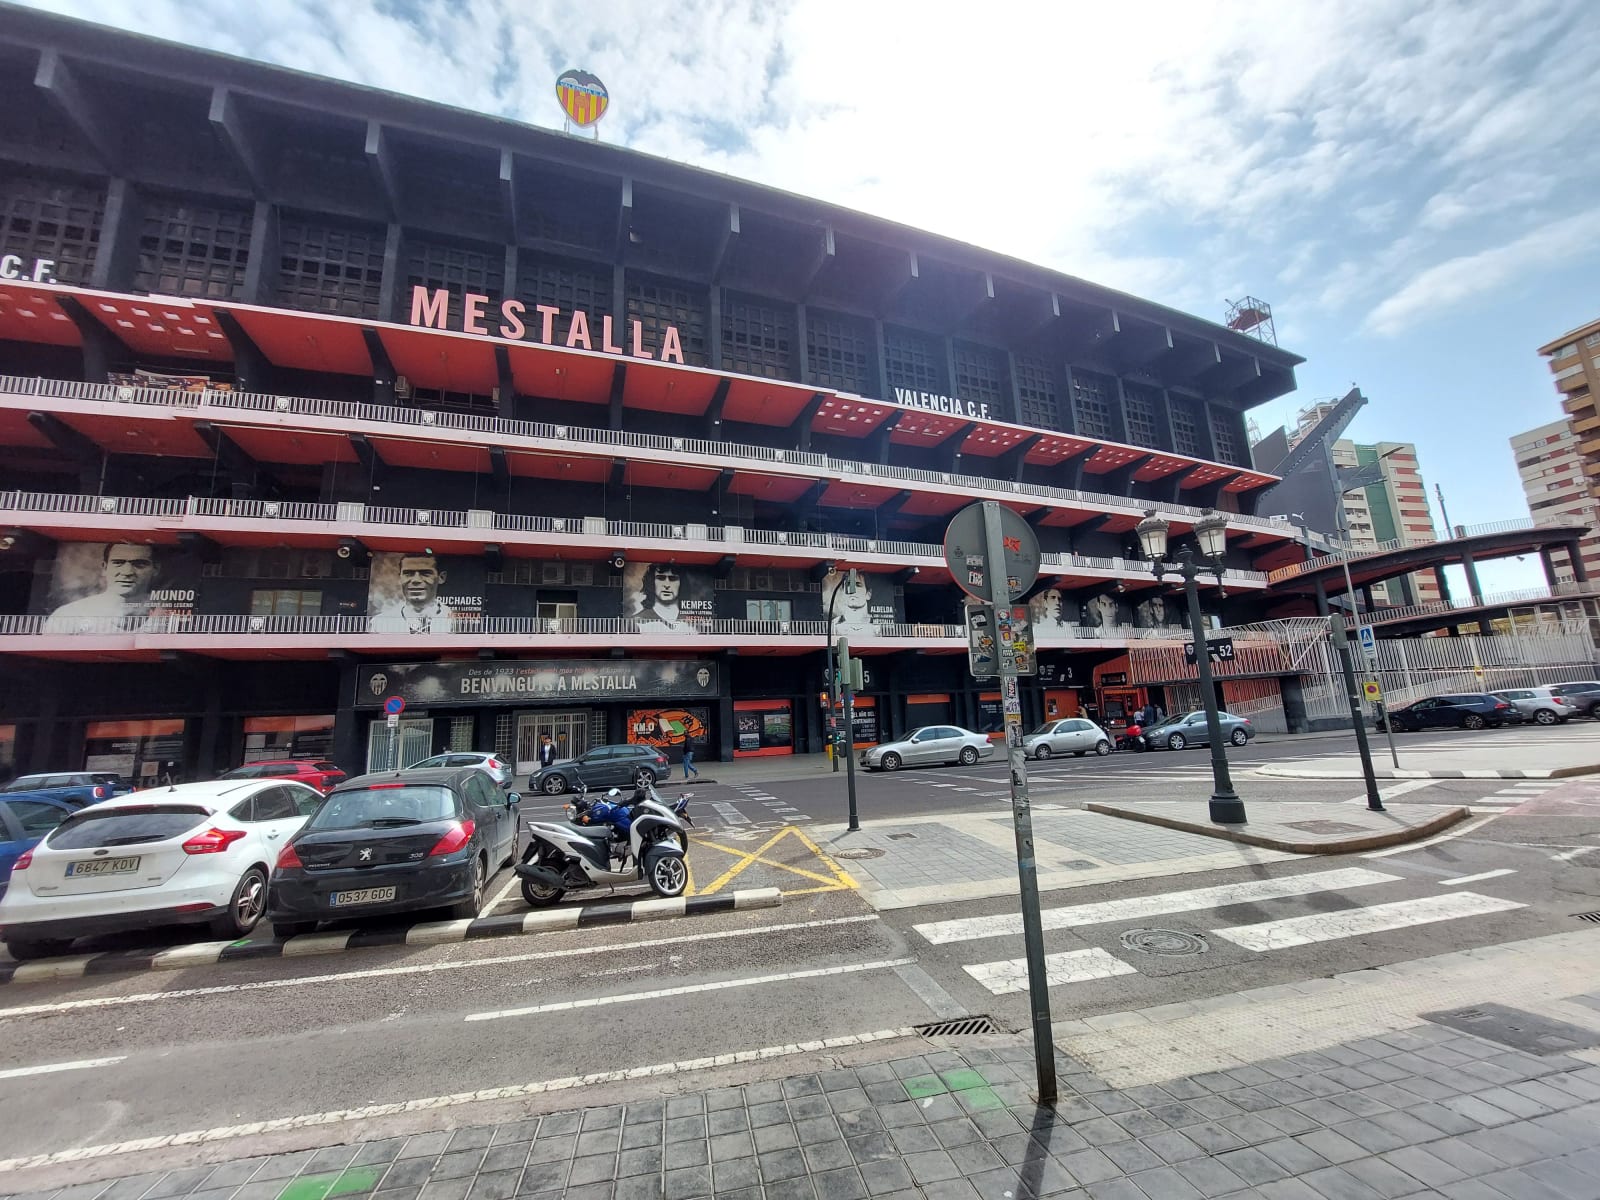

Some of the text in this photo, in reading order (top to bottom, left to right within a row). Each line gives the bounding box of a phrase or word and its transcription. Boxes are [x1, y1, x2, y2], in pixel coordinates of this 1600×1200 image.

[410, 285, 684, 364] MESTALLA
[894, 387, 993, 420] VALENCIA C.F.
[150, 590, 194, 601] MUNDO
[437, 596, 482, 605] PUCHADES
[681, 600, 713, 609] KEMPES
[1219, 645, 1232, 656] 52
[863, 670, 871, 683] 5
[1067, 667, 1073, 679] 3
[558, 675, 567, 691] A
[571, 675, 637, 690] MESTALLA
[76, 859, 136, 874] 6847 KDV
[338, 888, 393, 903] 0537 GDG
